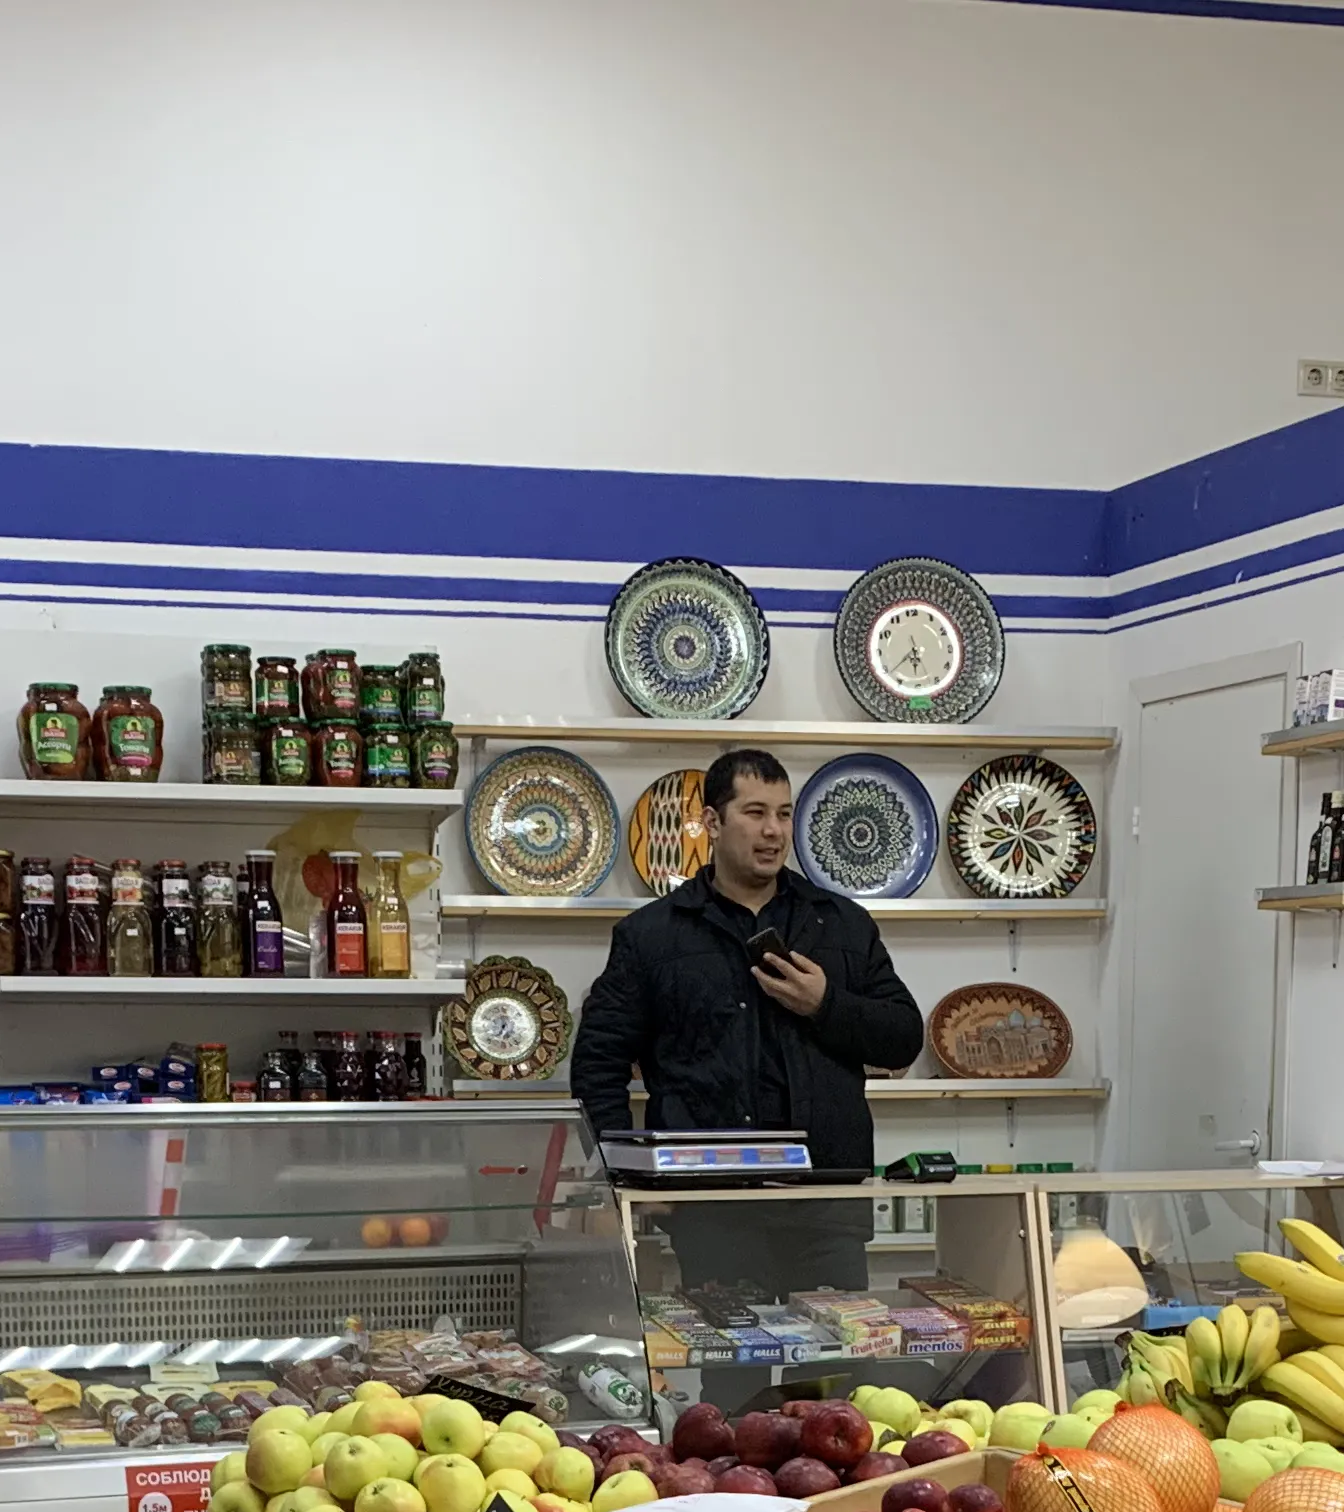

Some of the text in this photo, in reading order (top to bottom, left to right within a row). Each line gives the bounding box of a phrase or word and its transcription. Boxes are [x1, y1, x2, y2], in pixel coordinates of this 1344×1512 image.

[753, 1348, 781, 1359] HALLS
[908, 1339, 965, 1355] mentos
[705, 1350, 733, 1360] HALLS
[135, 1468, 211, 1486] СОБЛЮД
